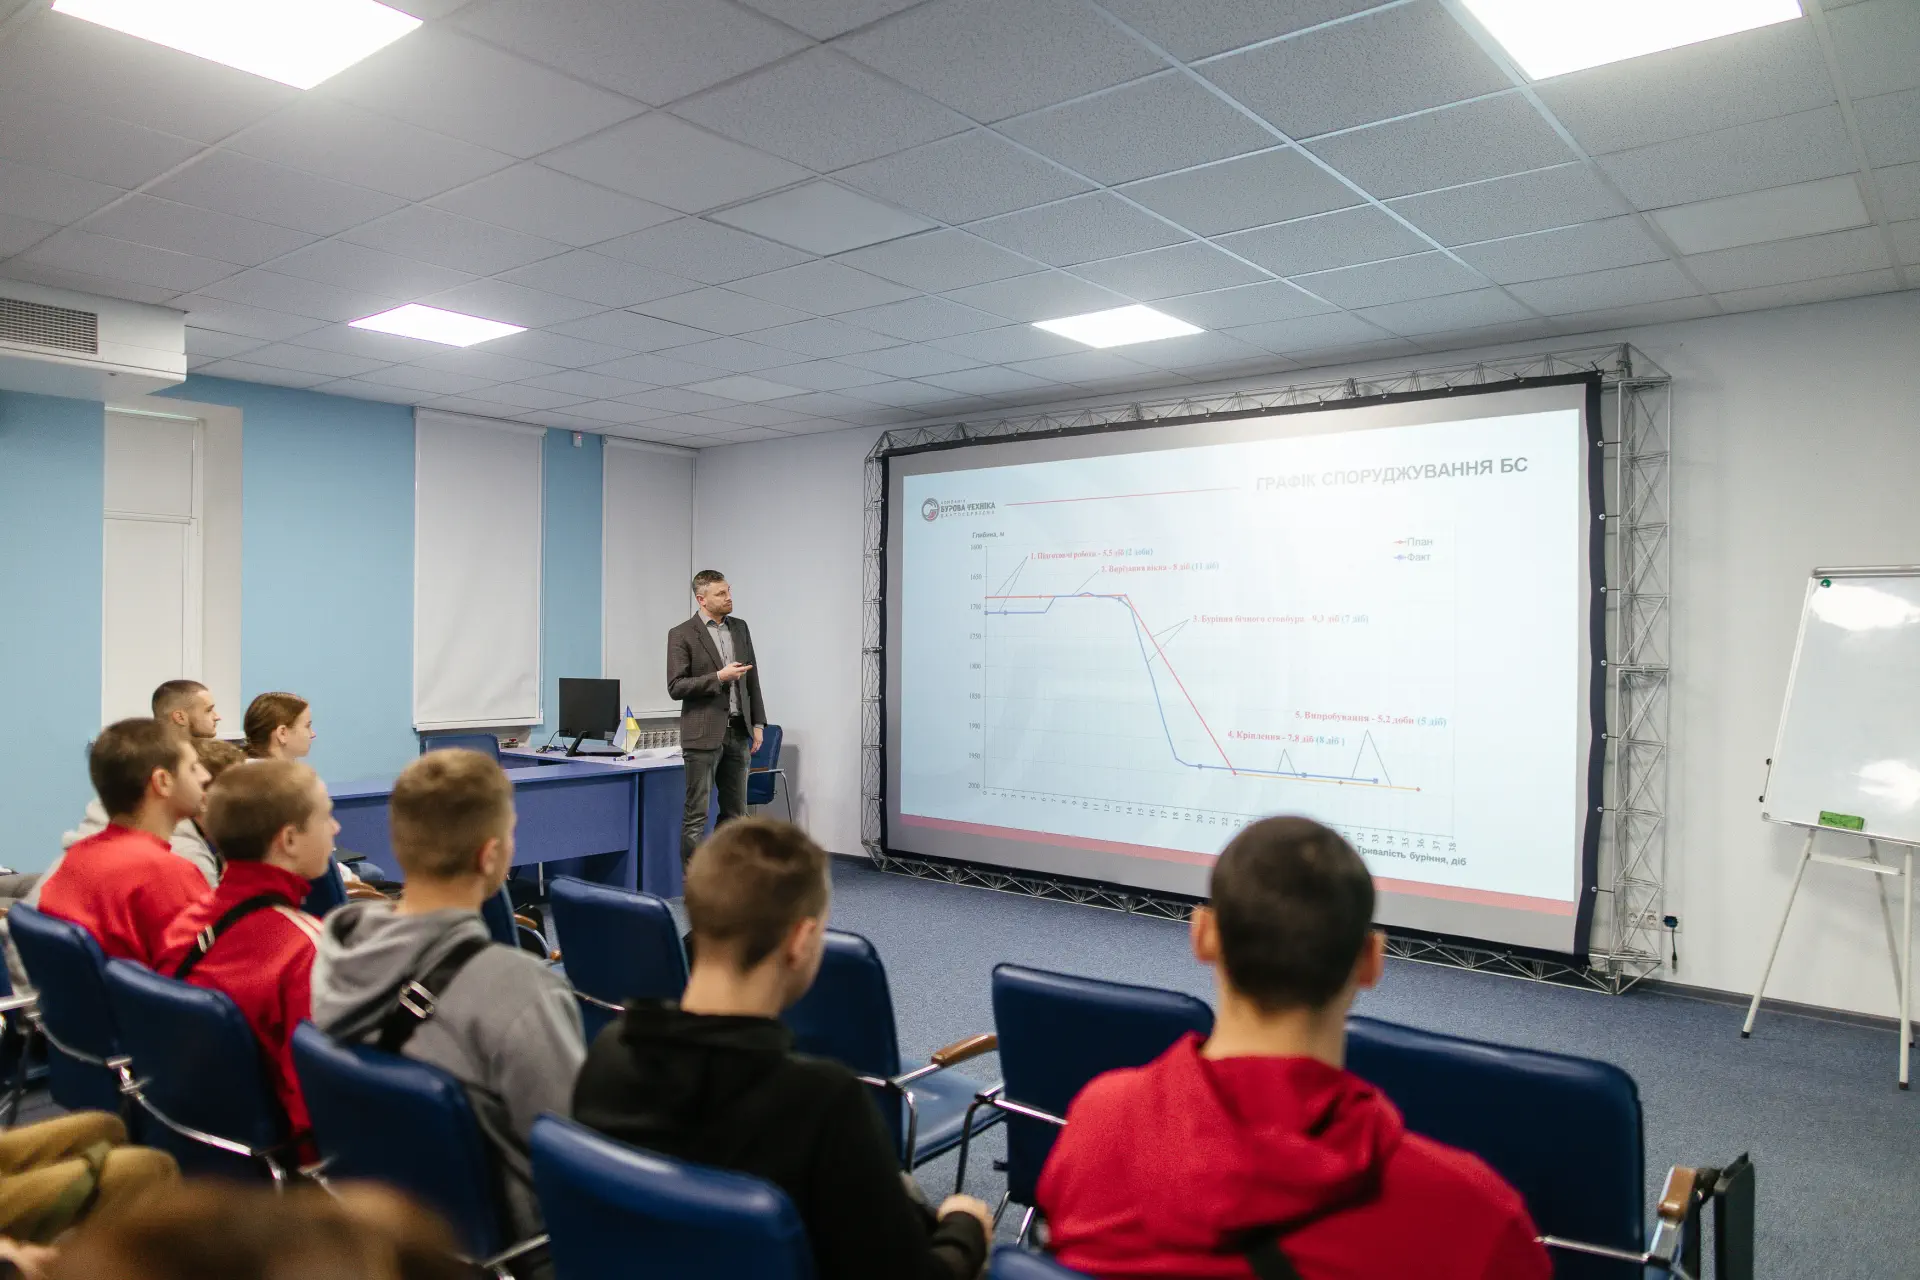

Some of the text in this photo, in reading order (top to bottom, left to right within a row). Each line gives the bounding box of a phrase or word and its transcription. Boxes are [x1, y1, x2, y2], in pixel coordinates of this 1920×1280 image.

[1256, 457, 1528, 490] ГРАФІК СПОРУДЖУВАННЯ БС
[940, 504, 966, 512] БУРОВА
[1407, 537, 1432, 546] План
[1407, 552, 1430, 562] Факт
[1304, 711, 1369, 722] Випробування
[1392, 716, 1414, 724] доби
[1236, 730, 1280, 741] Кріплення
[1358, 846, 1466, 866] Тривалість буріння, діб
